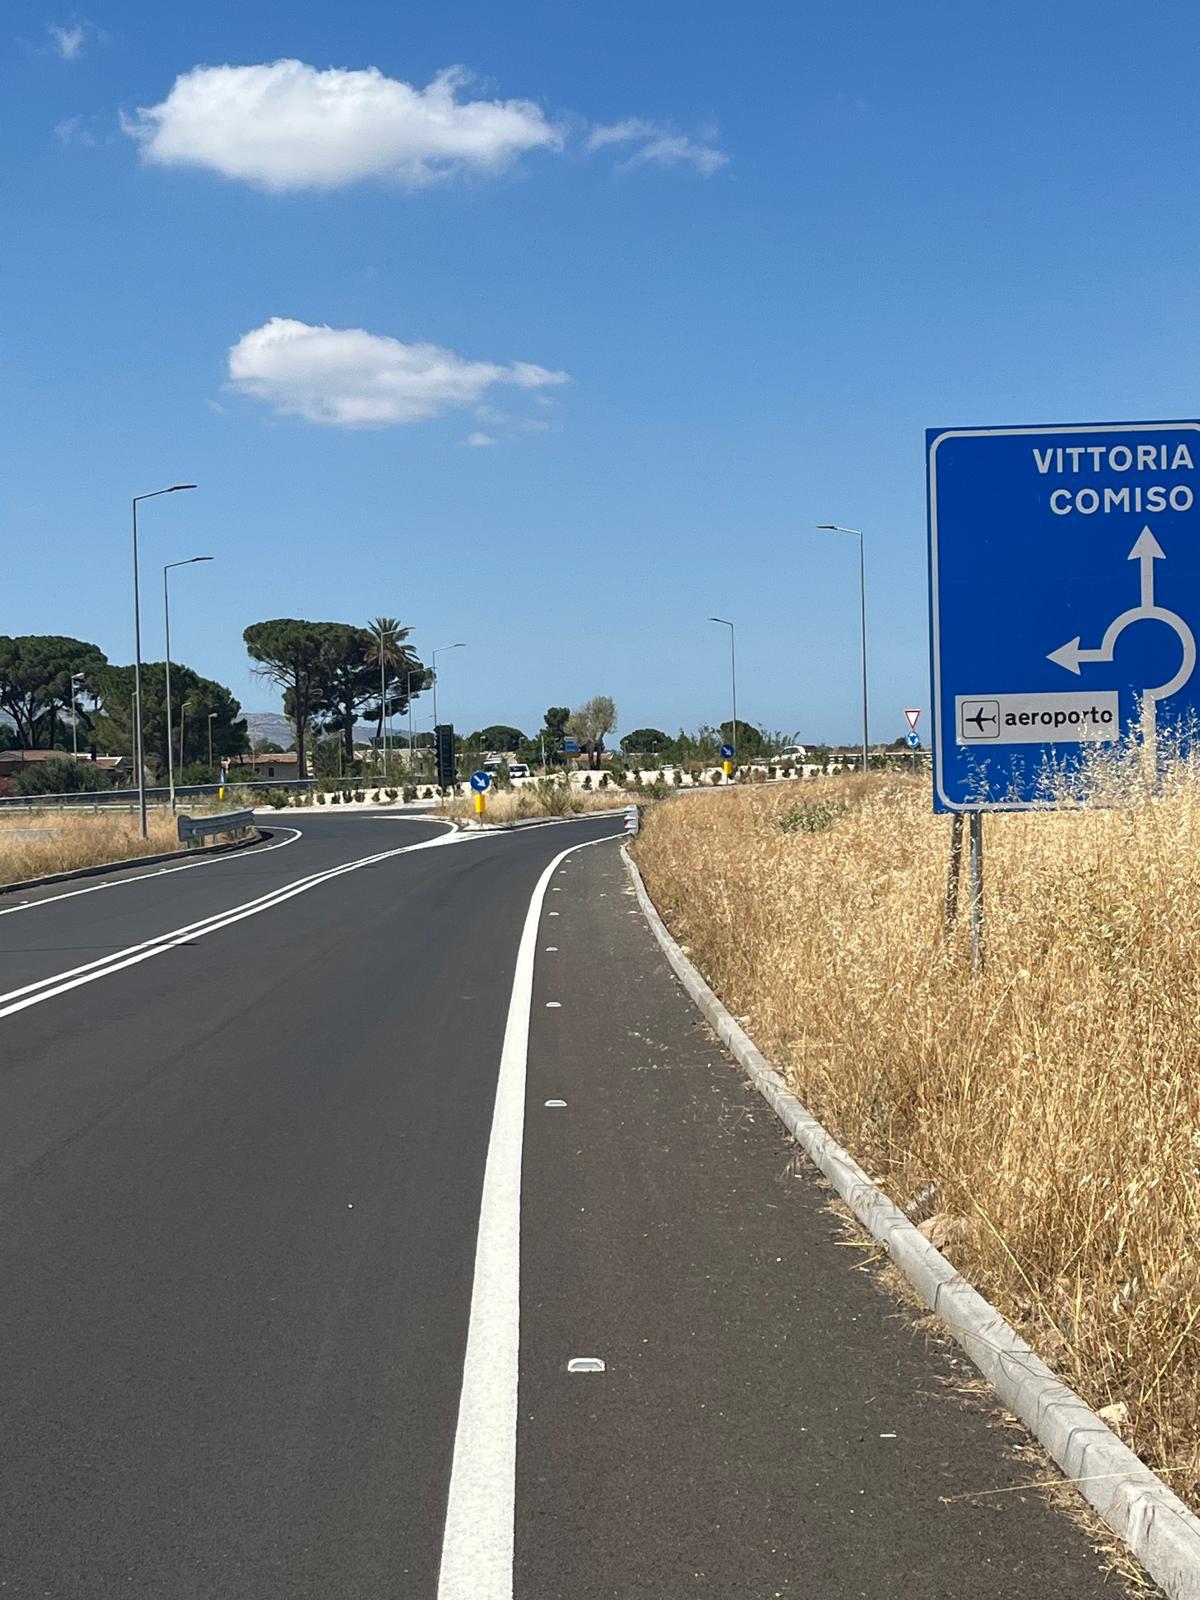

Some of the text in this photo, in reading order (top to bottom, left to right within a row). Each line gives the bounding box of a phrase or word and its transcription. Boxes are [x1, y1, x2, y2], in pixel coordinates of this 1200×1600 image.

[1032, 444, 1194, 473] VITTORIA
[1050, 485, 1194, 515] COMISO
[1005, 706, 1113, 728] aeroporto
